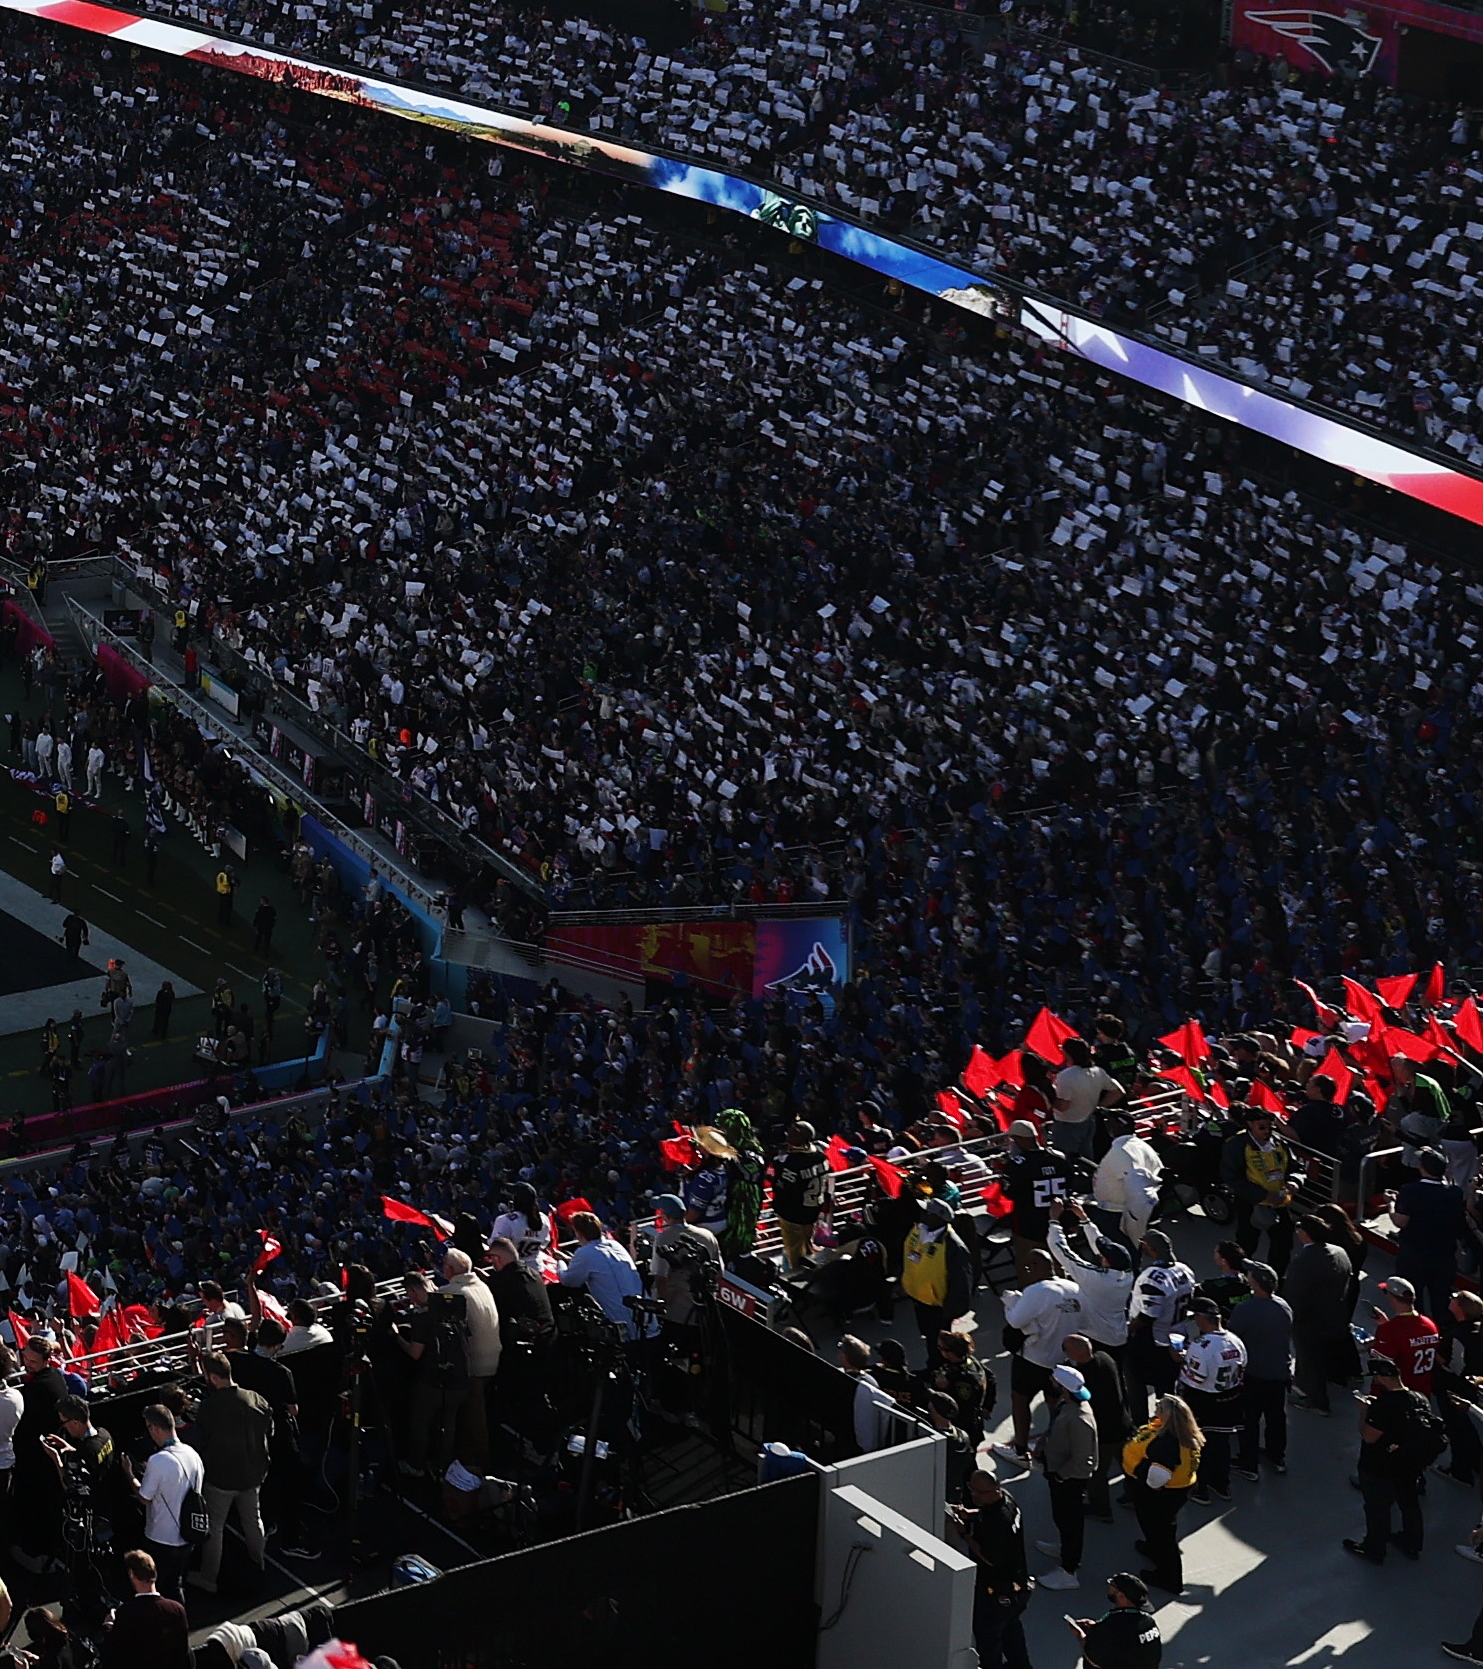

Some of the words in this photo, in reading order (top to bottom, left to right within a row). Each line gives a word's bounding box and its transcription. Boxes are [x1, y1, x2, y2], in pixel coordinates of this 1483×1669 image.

[1032, 1176, 1067, 1209] 25
[720, 1286, 747, 1311] 6W
[1413, 1347, 1436, 1375] 23
